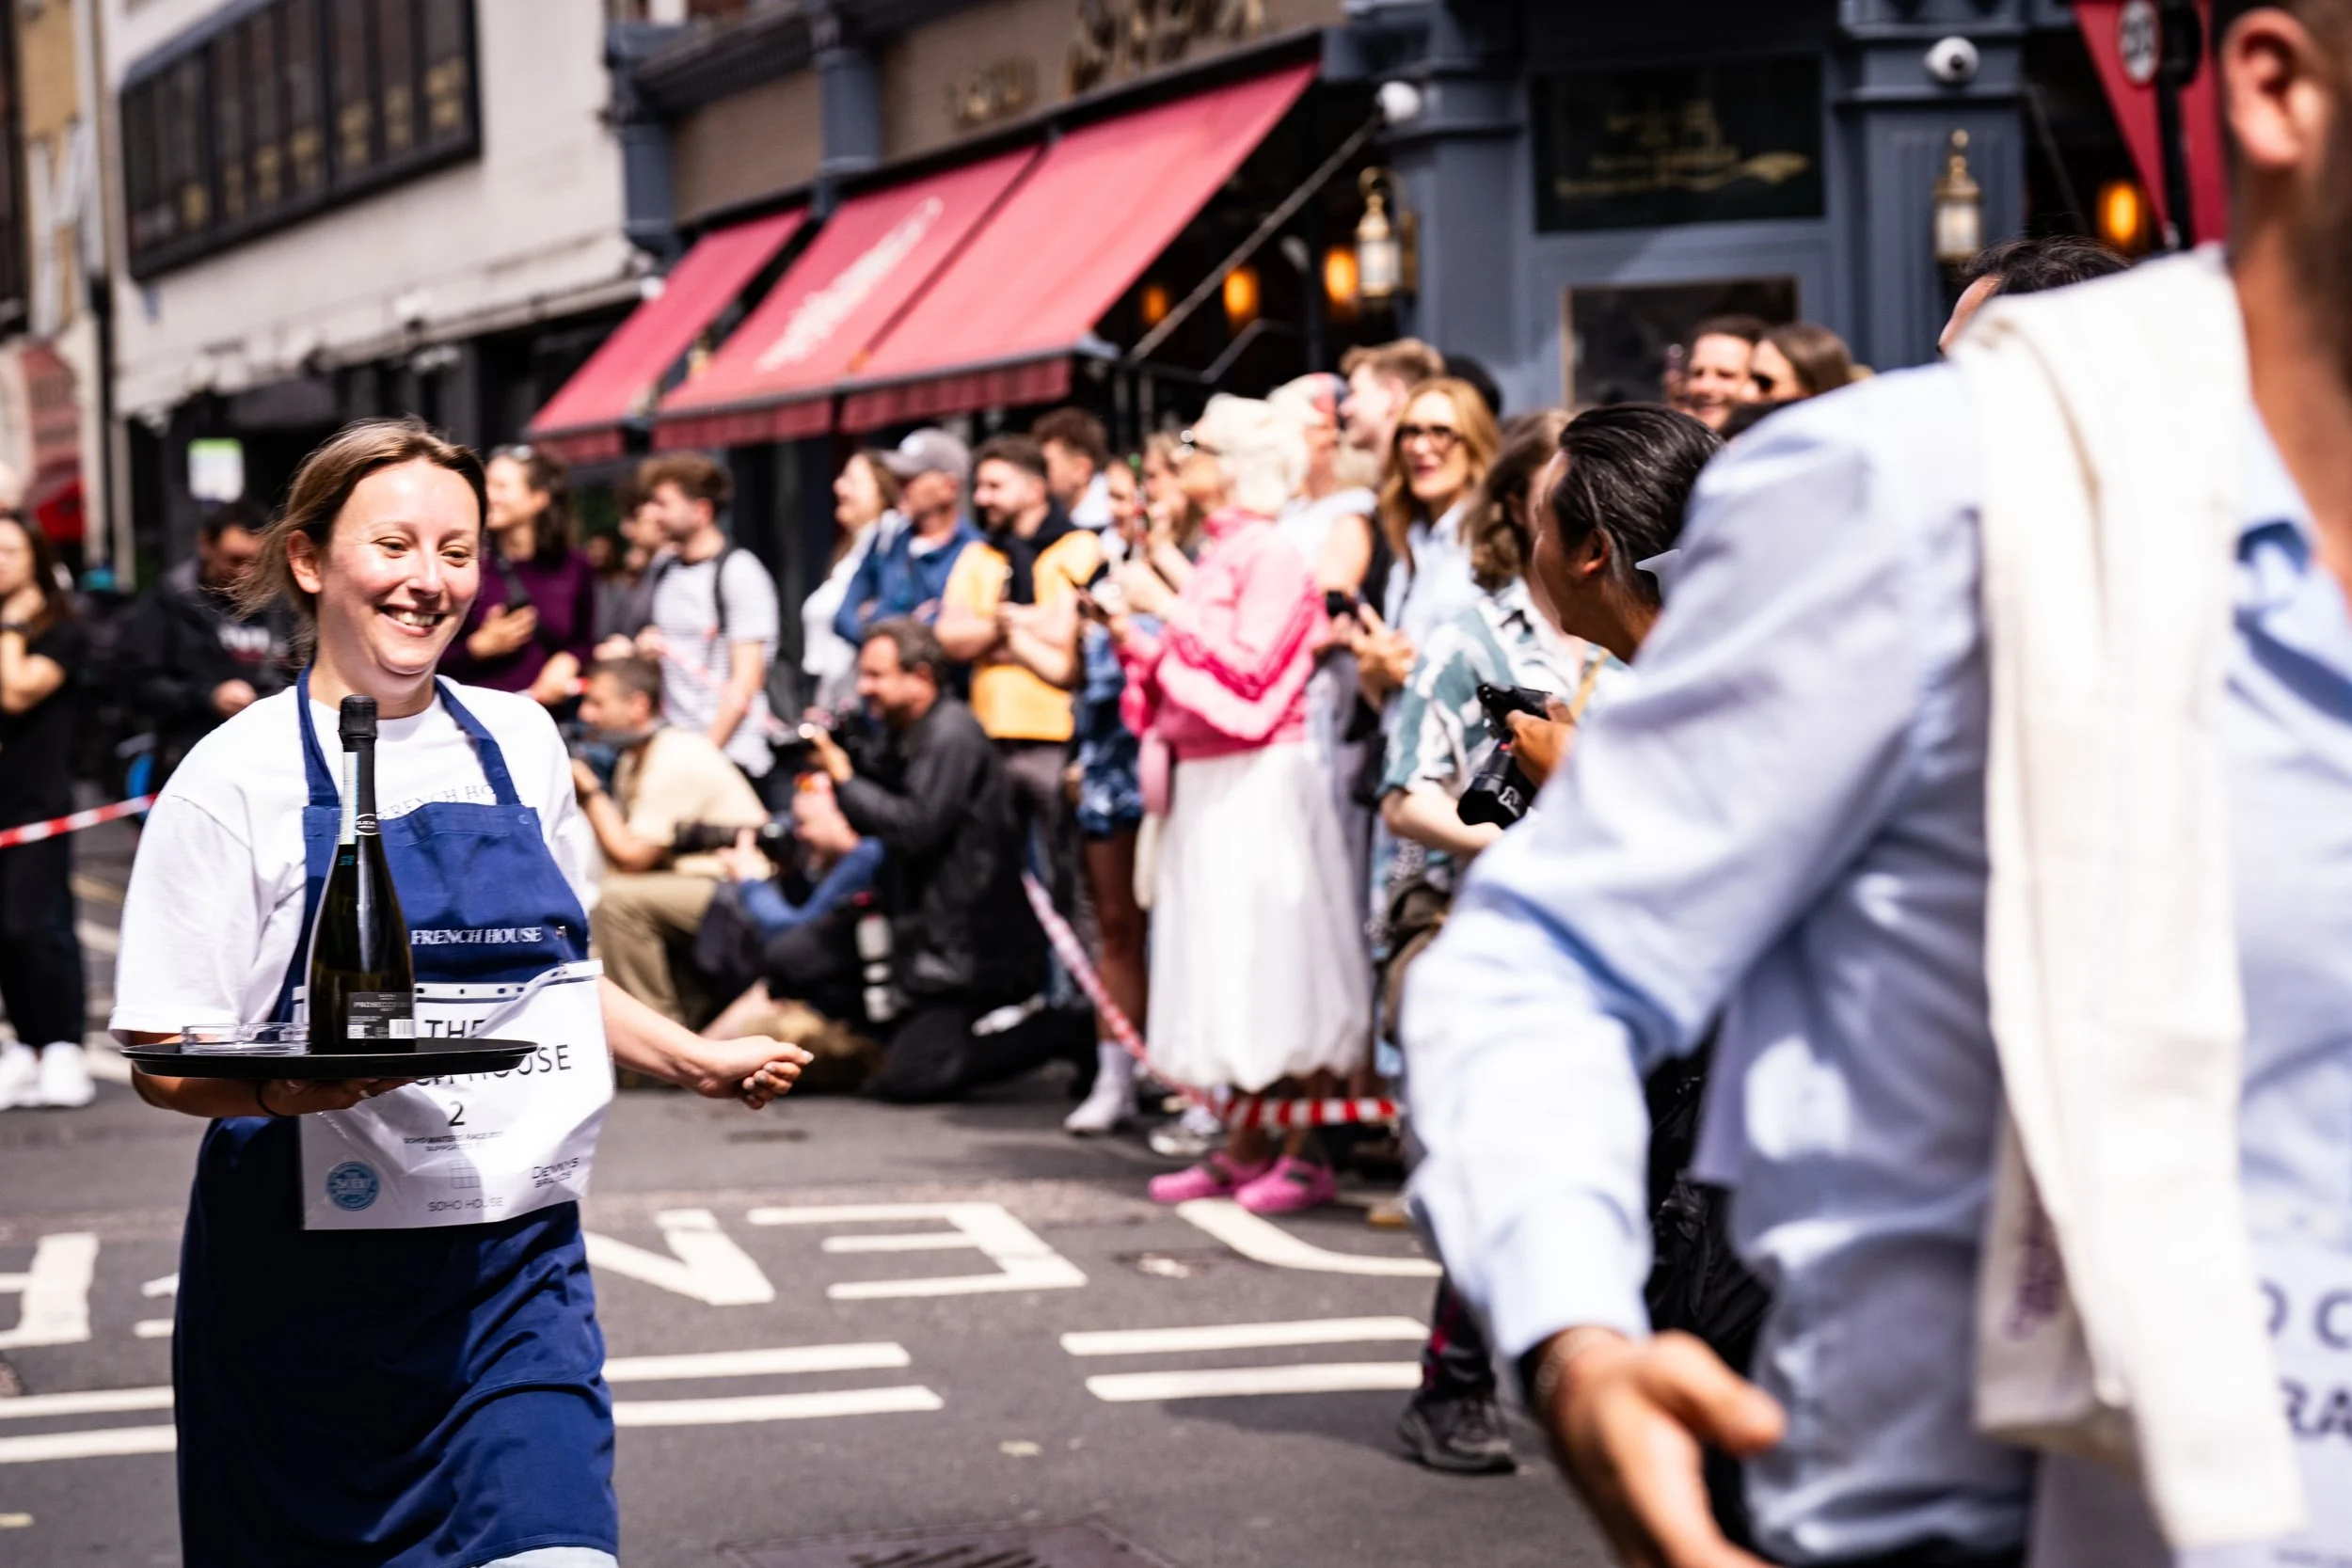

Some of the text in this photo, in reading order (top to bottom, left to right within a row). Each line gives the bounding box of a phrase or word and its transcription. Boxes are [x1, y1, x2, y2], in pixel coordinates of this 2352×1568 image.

[409, 927, 543, 945] FRENCH HOUSE
[448, 1101, 466, 1128] 2
[427, 1200, 463, 1212] SOHO
